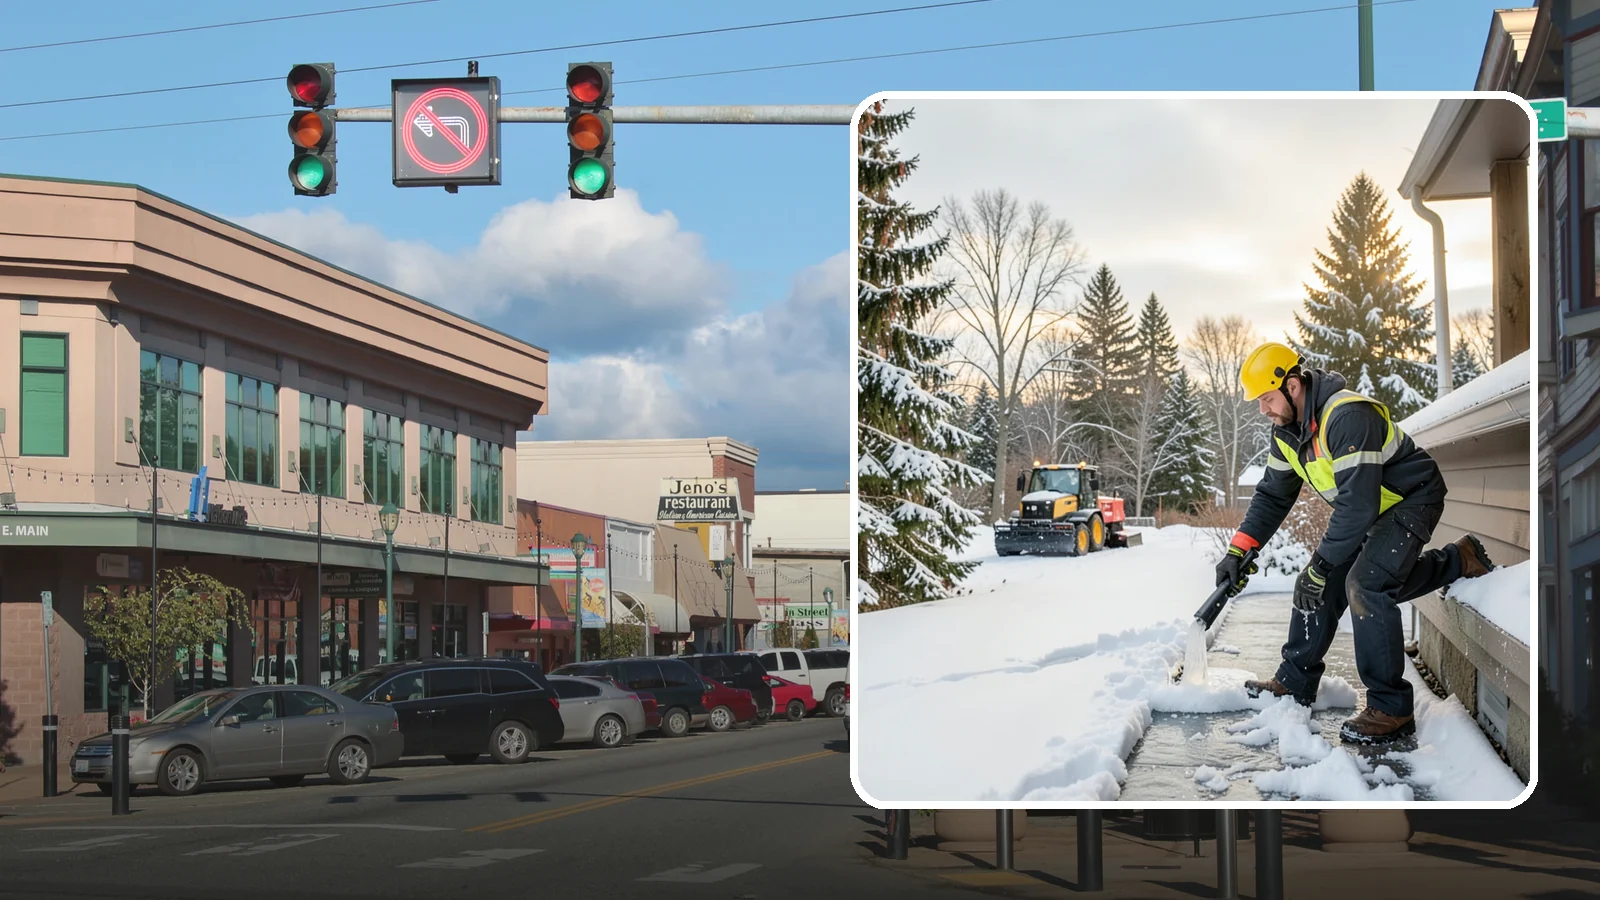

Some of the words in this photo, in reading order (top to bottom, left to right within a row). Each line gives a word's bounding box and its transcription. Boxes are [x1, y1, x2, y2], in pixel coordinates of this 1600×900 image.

[669, 480, 728, 494] Jeno's
[665, 496, 731, 509] restaurant
[659, 509, 681, 520] Italian
[685, 509, 714, 520] American
[715, 509, 738, 519] Cuisine
[2, 525, 13, 536] E.
[15, 525, 49, 536] MAIN
[797, 607, 828, 617] Street
